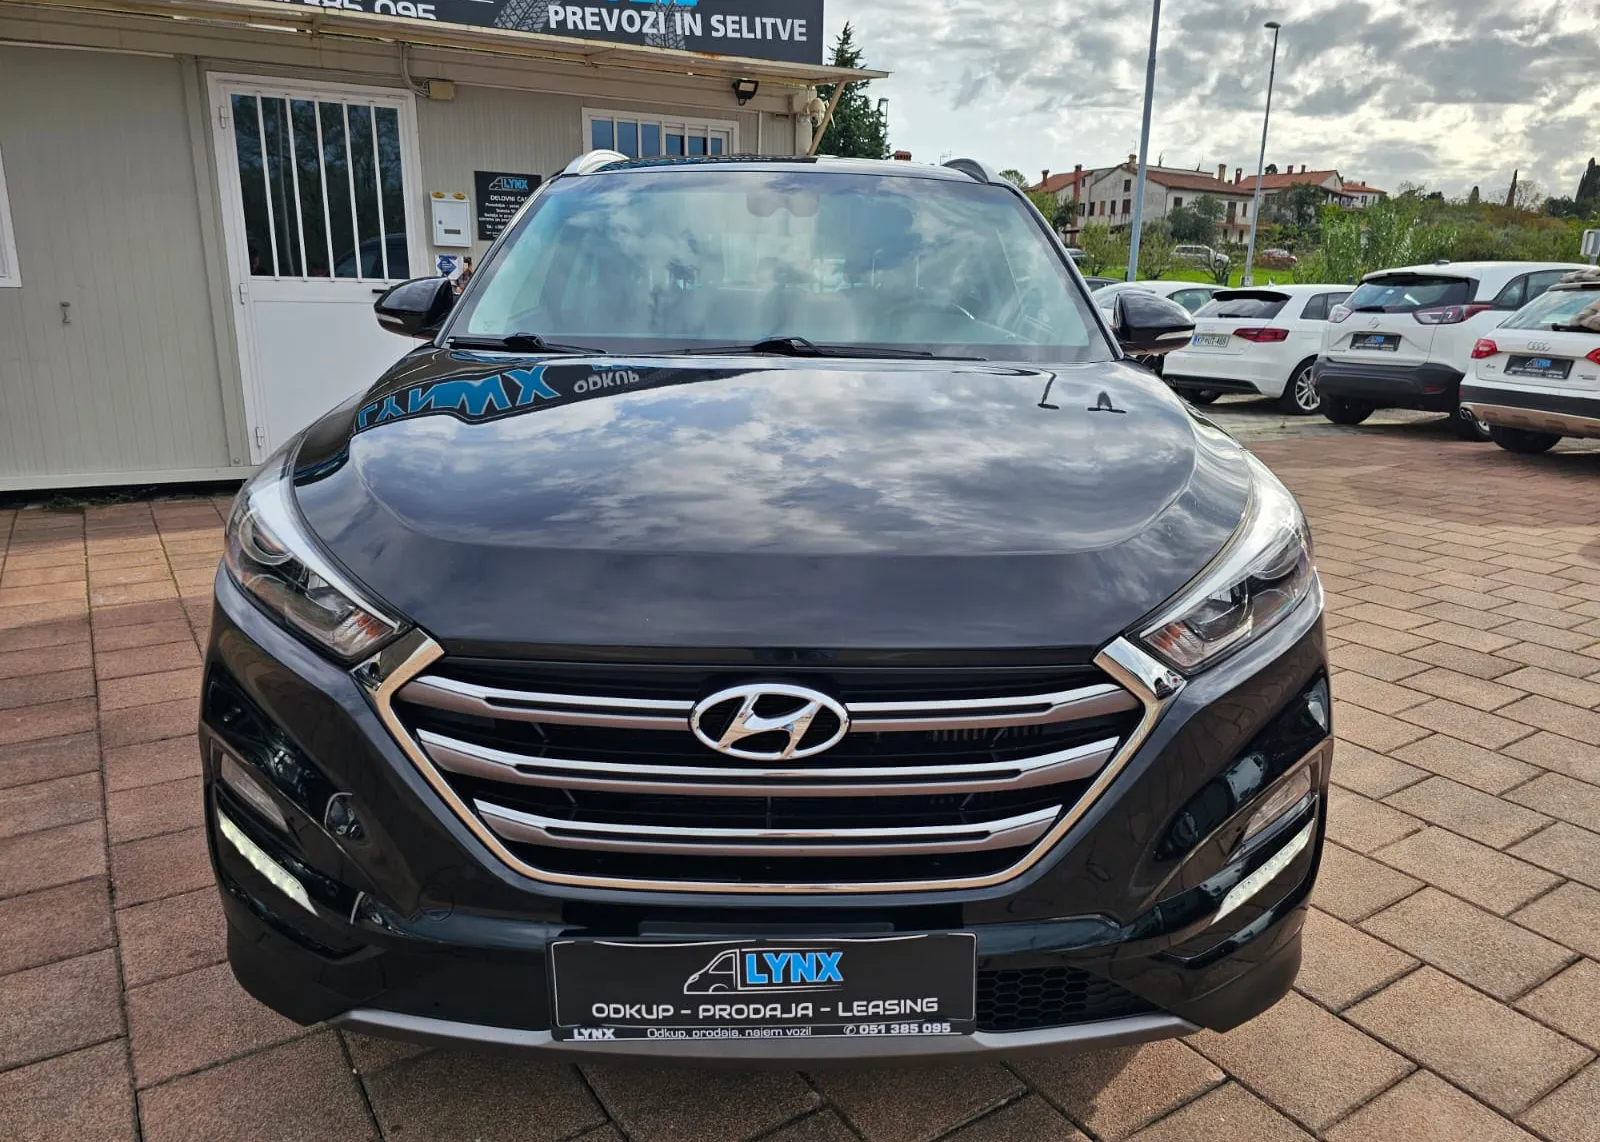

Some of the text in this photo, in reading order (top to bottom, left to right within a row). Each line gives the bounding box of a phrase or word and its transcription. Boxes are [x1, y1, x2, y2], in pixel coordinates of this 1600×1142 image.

[548, 5, 808, 41] PREVOZI IN SELITVE
[503, 178, 528, 190] LYNX
[745, 952, 844, 984] LYNX
[592, 1003, 674, 1019] ODKUP
[698, 1002, 813, 1019] PRODAJA
[838, 997, 938, 1017] LEASING
[573, 1028, 616, 1040] LYNX
[786, 1026, 812, 1037] vozil
[859, 1024, 886, 1035] 051
[890, 1023, 919, 1034] 385
[922, 1022, 951, 1034] 095
